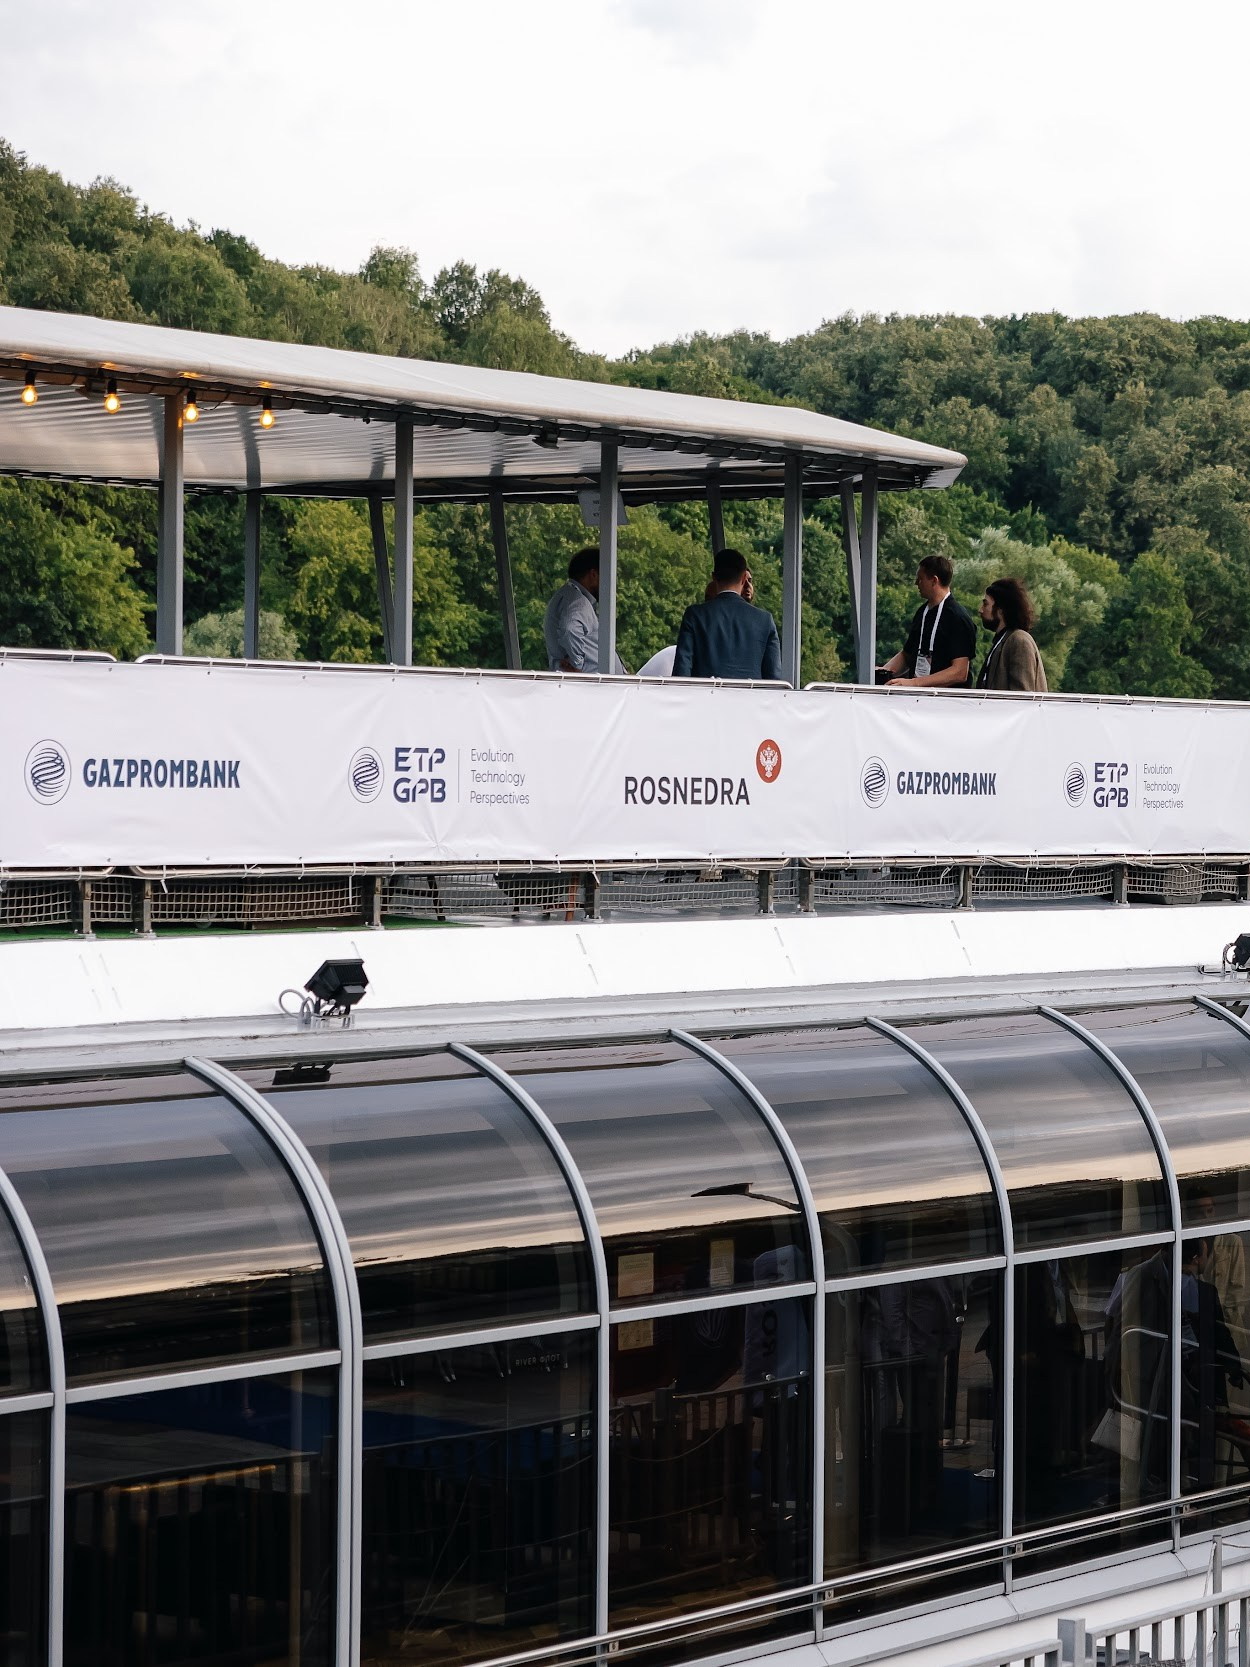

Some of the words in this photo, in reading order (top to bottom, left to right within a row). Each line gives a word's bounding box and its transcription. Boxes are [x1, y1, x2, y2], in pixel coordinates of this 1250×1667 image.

[394, 746, 446, 773] ETP
[470, 748, 514, 763] Evolution
[82, 758, 241, 789] GAZPROMBANK
[470, 769, 526, 787] Technology
[1094, 762, 1129, 783] ETP
[1143, 763, 1173, 775] Evolution
[392, 777, 447, 804] GPB
[624, 775, 751, 806] ROSNEDRA
[896, 770, 997, 797] GAZPROMBANK
[1143, 780, 1181, 795] Technology
[469, 790, 530, 807] Perspectives
[1093, 786, 1129, 808] GPB
[1142, 797, 1184, 812] Perspectives
